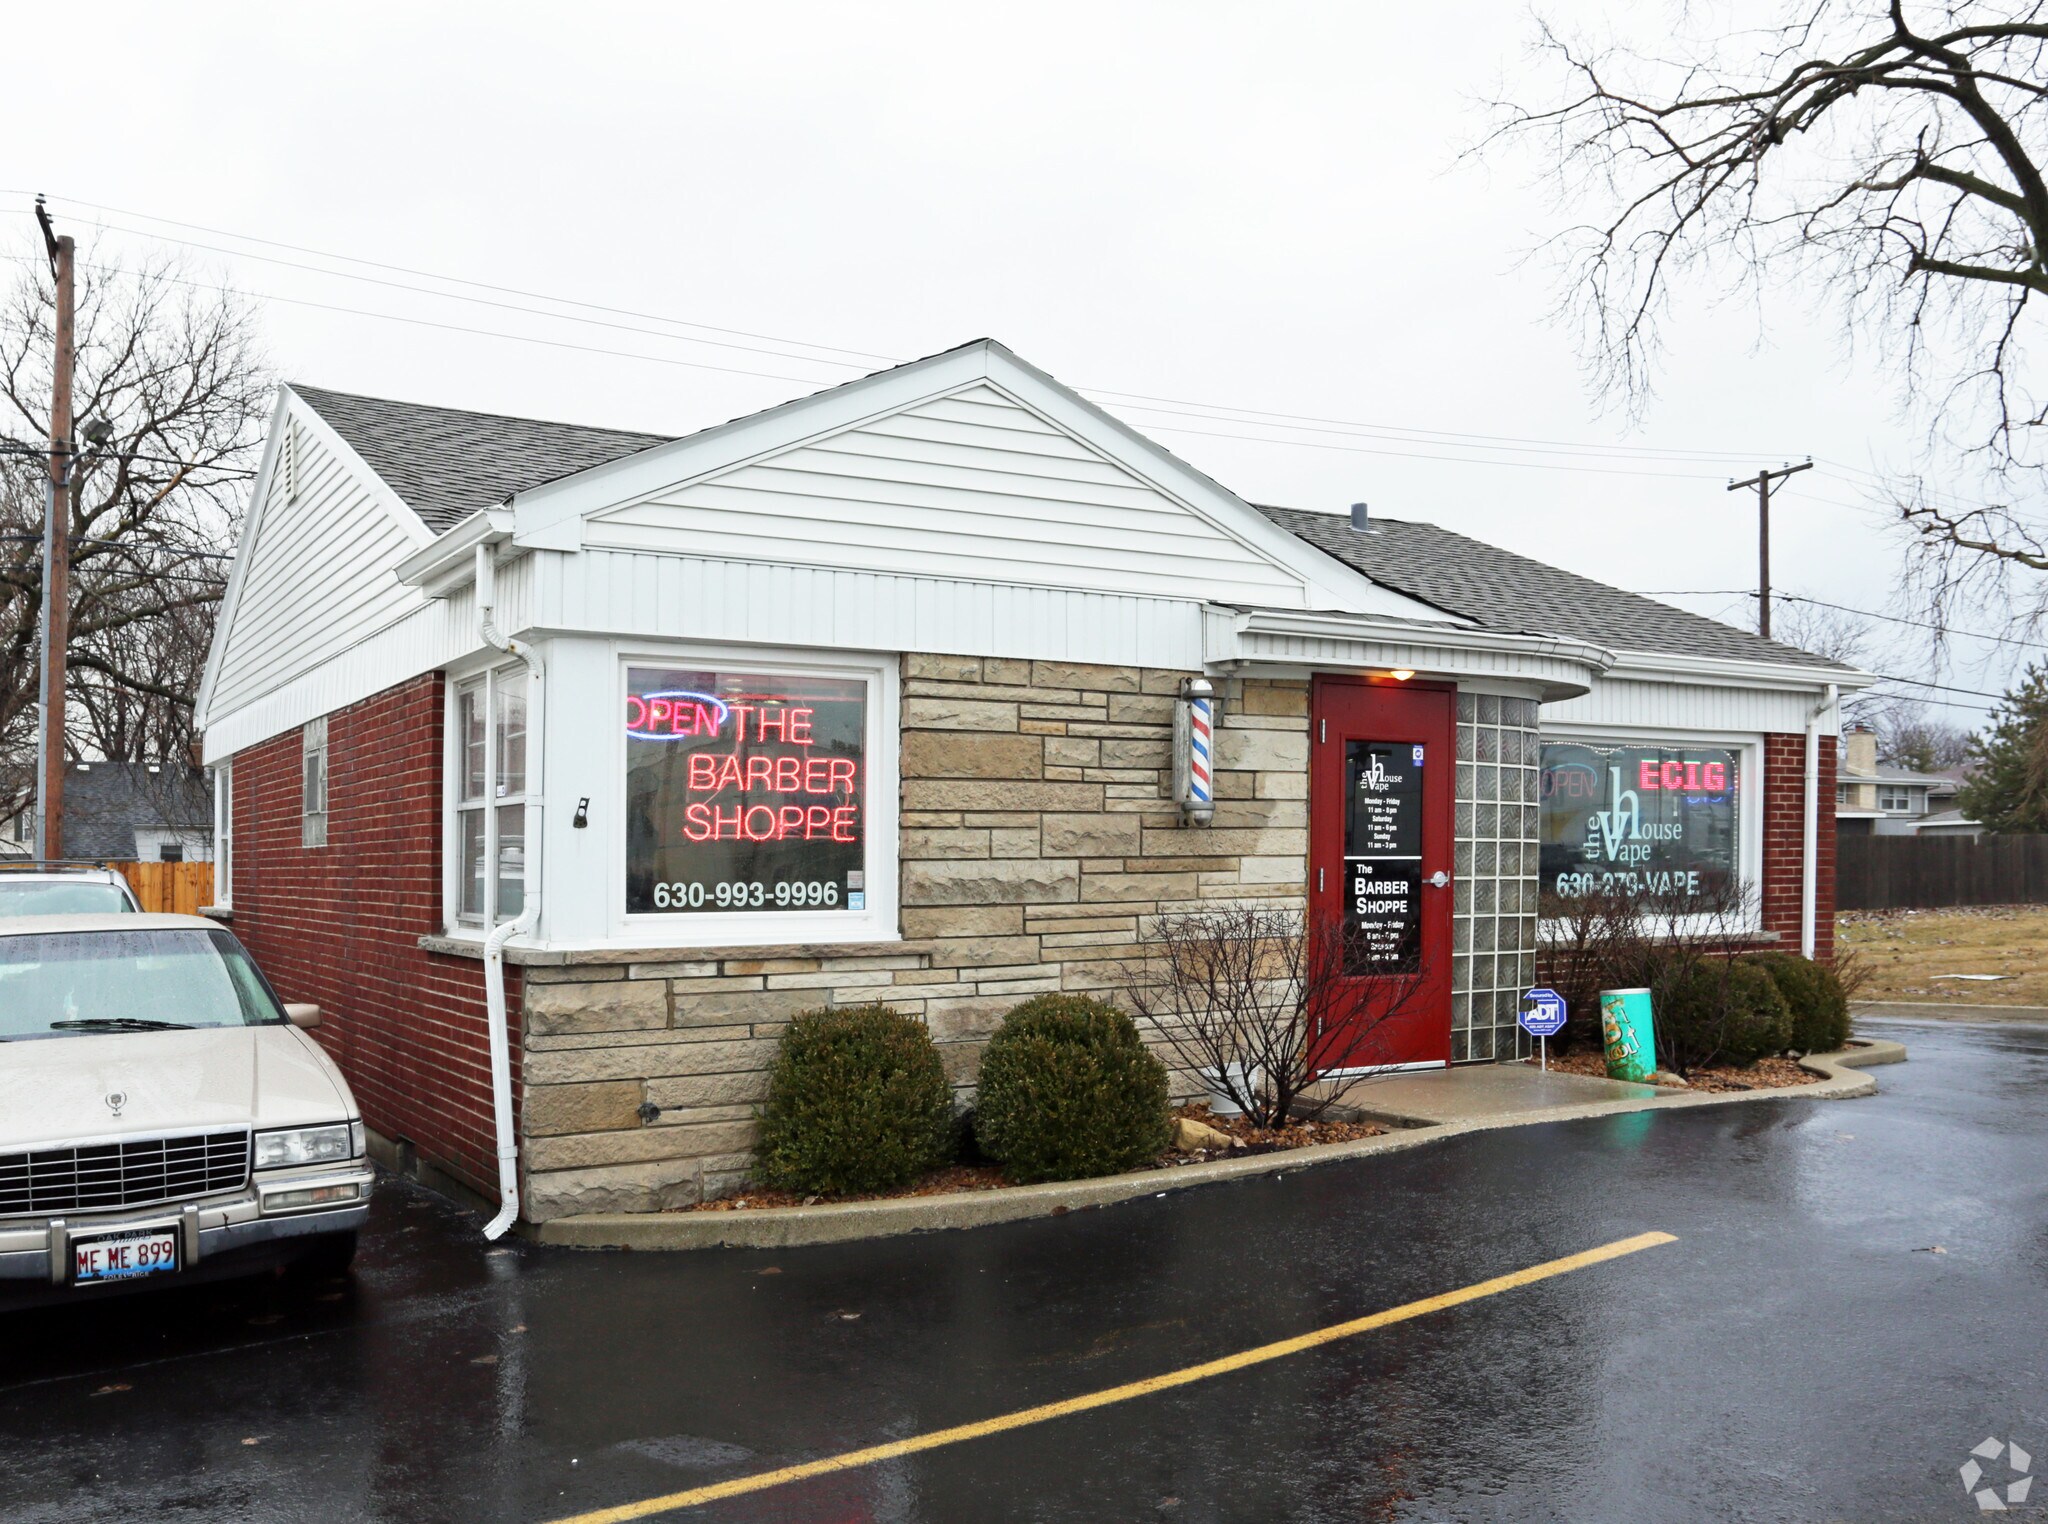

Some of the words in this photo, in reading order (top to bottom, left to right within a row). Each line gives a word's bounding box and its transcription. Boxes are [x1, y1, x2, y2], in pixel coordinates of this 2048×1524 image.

[626, 695, 720, 737] OPEN
[728, 706, 813, 743] THE
[689, 754, 855, 793] BARBER
[1540, 771, 1594, 797] OPEN
[1639, 759, 1725, 791] ECIG
[1386, 798, 1400, 806] Friday
[684, 803, 857, 841] SHOPPE
[1372, 815, 1392, 823] Saturday
[1583, 816, 1601, 860] the
[1356, 864, 1372, 874] The
[654, 881, 838, 907] 630-993-9996
[1355, 877, 1408, 895] BARBER
[1356, 897, 1408, 914] SHOPPE
[1526, 1004, 1558, 1020] ADT
[76, 1250, 102, 1274] ME
[108, 1246, 130, 1270] ME
[138, 1241, 173, 1266] 899
